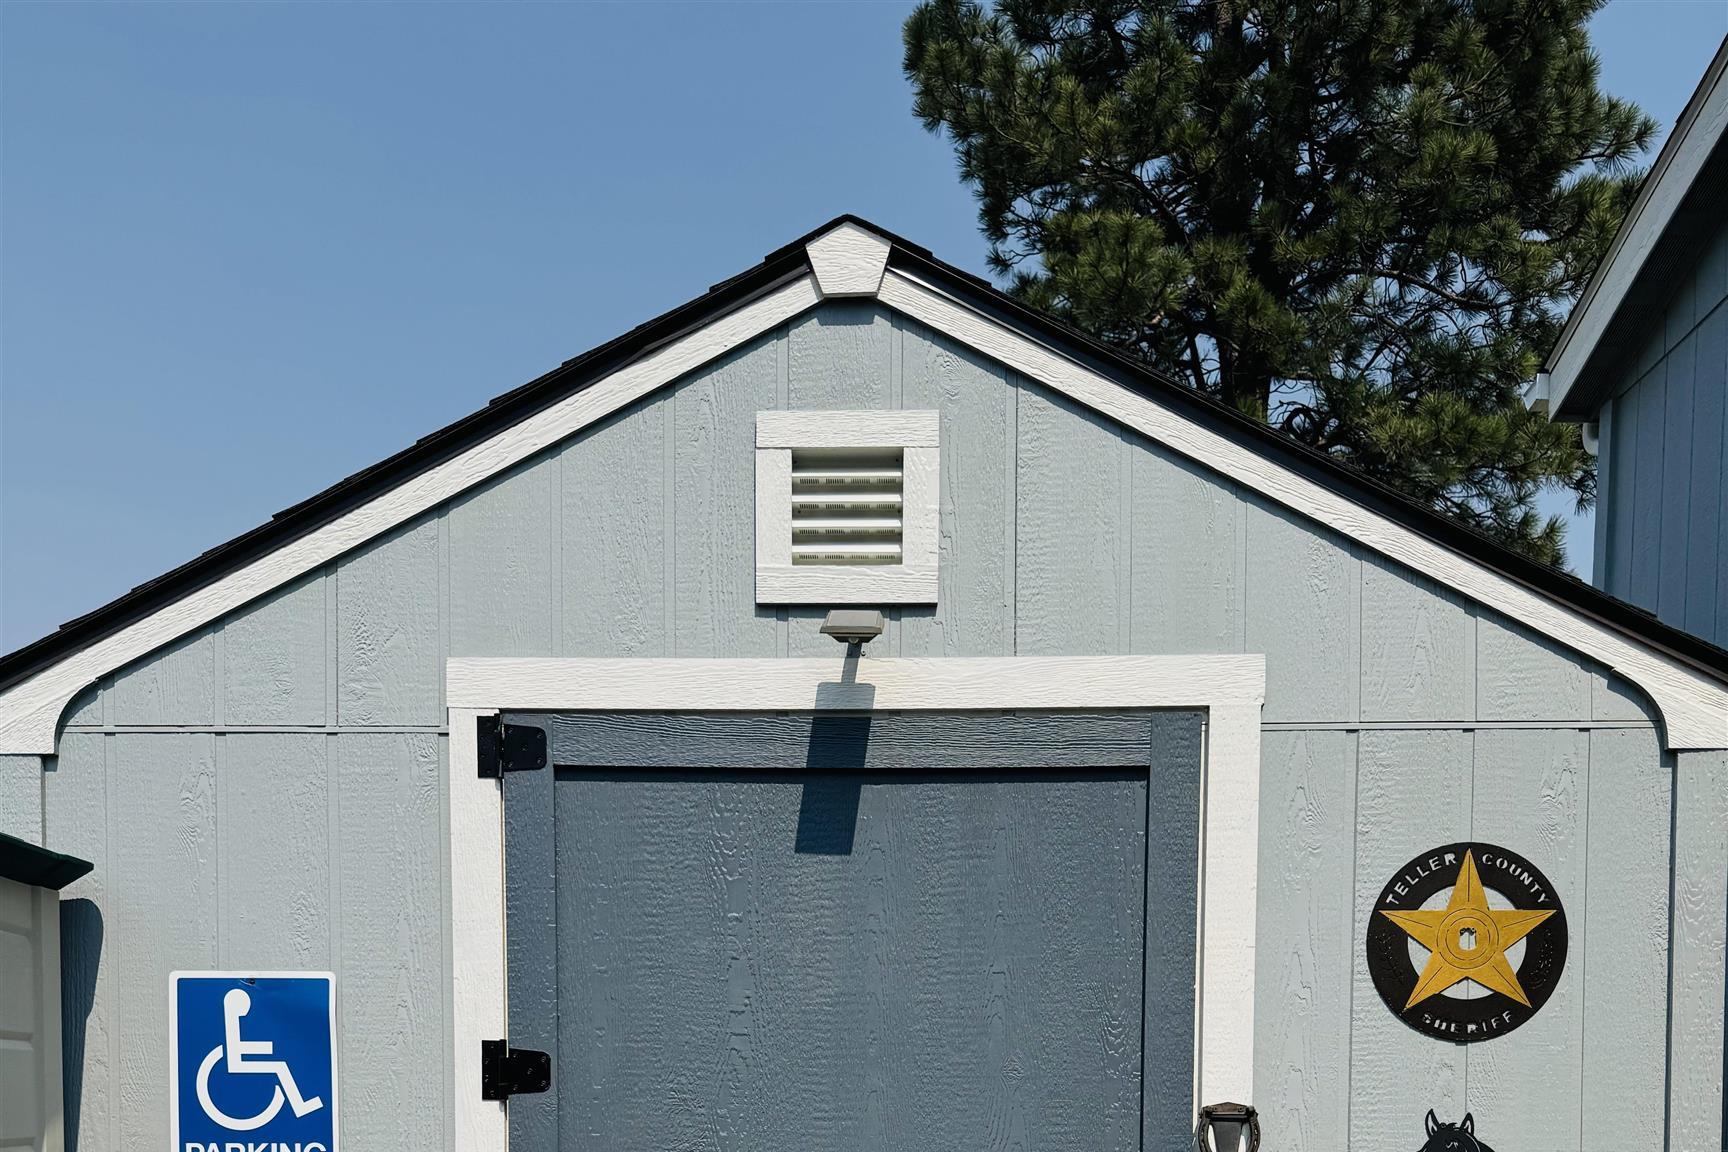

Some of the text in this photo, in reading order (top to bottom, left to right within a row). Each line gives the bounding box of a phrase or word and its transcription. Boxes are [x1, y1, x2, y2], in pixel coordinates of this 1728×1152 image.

[1386, 852, 1549, 907] TELLER COUNTY
[1420, 1010, 1513, 1034] SHERIFF
